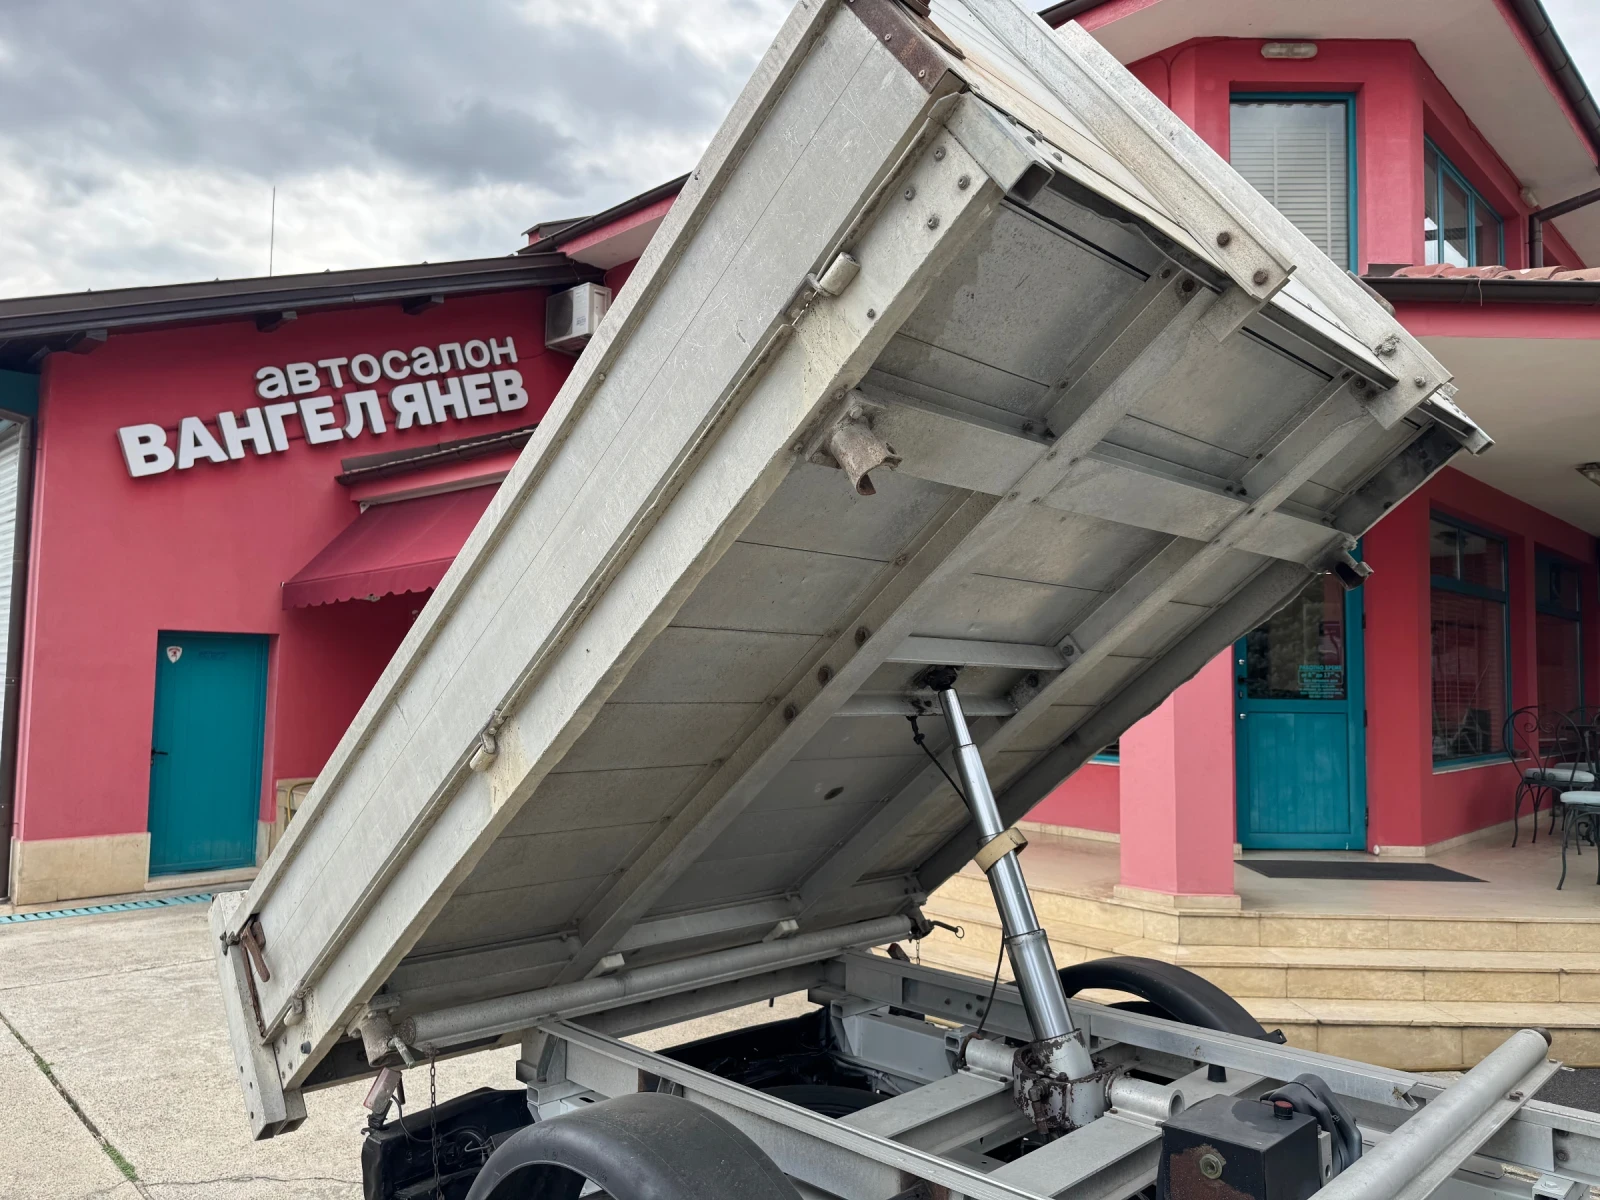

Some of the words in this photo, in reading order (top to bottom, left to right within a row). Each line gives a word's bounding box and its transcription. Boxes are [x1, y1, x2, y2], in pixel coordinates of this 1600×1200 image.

[255, 336, 518, 398] автосалон
[118, 390, 387, 477] ВАНГЕЛ
[391, 370, 528, 430] ЯНЕВ
